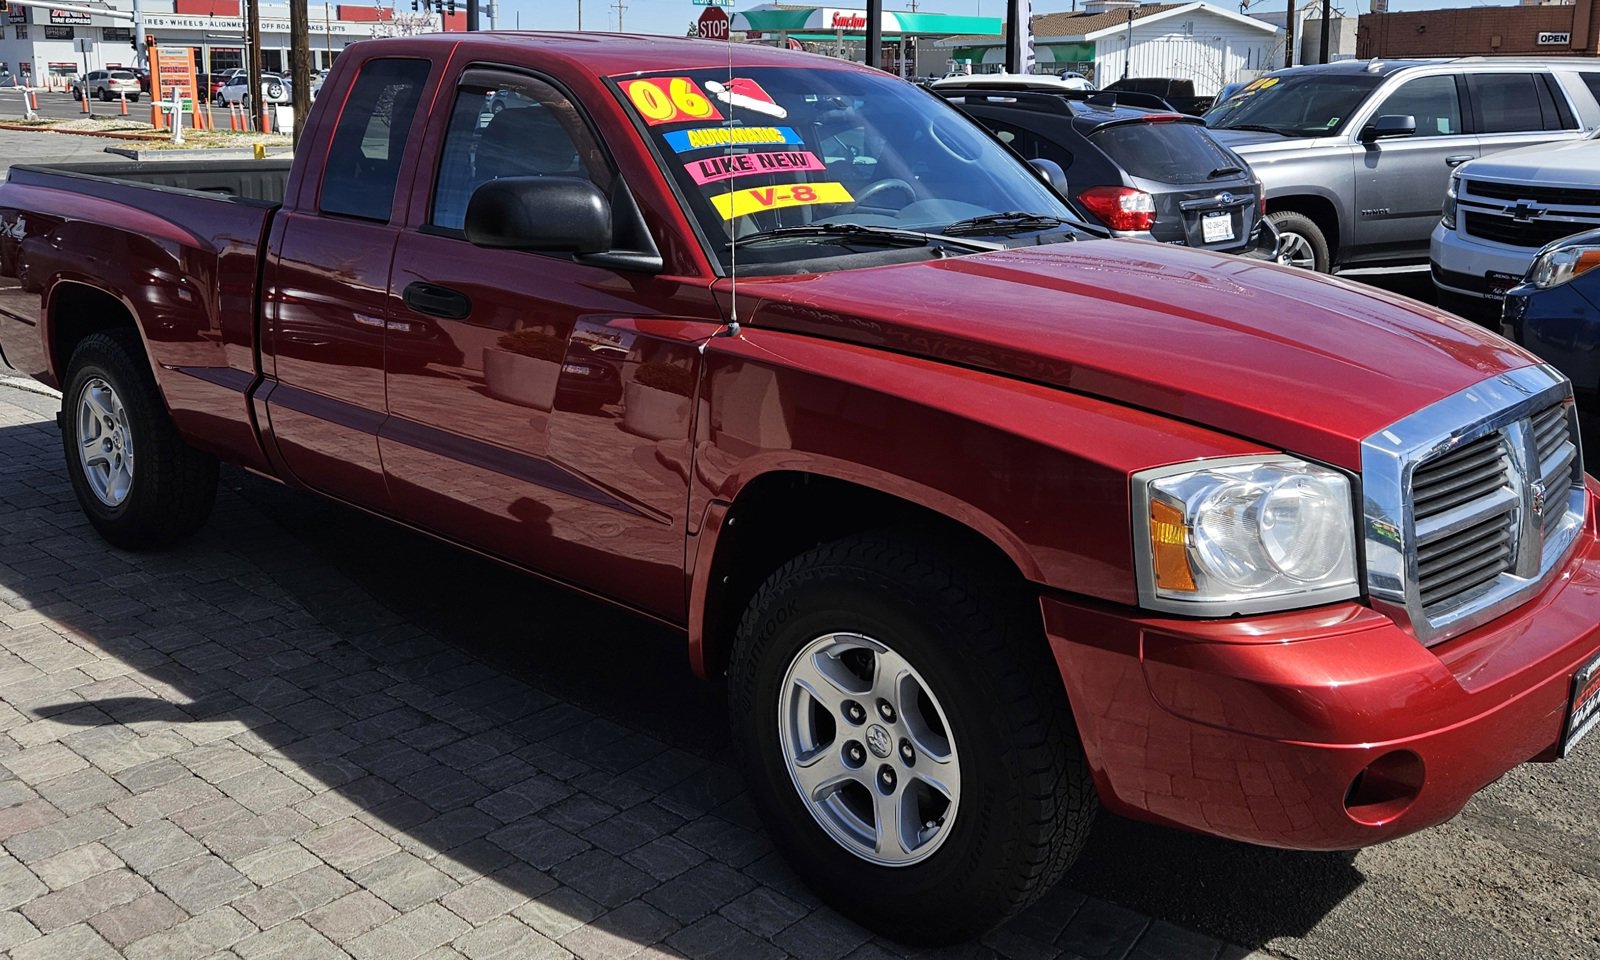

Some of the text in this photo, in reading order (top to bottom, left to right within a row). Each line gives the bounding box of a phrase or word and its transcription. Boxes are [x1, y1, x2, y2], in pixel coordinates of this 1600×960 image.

[169, 19, 204, 27] WHEELS
[700, 20, 728, 38] STOP
[1540, 34, 1568, 43] OPEN
[628, 78, 713, 120] 06
[687, 126, 786, 148] AUTOMATIC
[699, 152, 810, 180] LIKE NEW
[749, 185, 819, 207] V-8
[0, 214, 27, 241] x4
